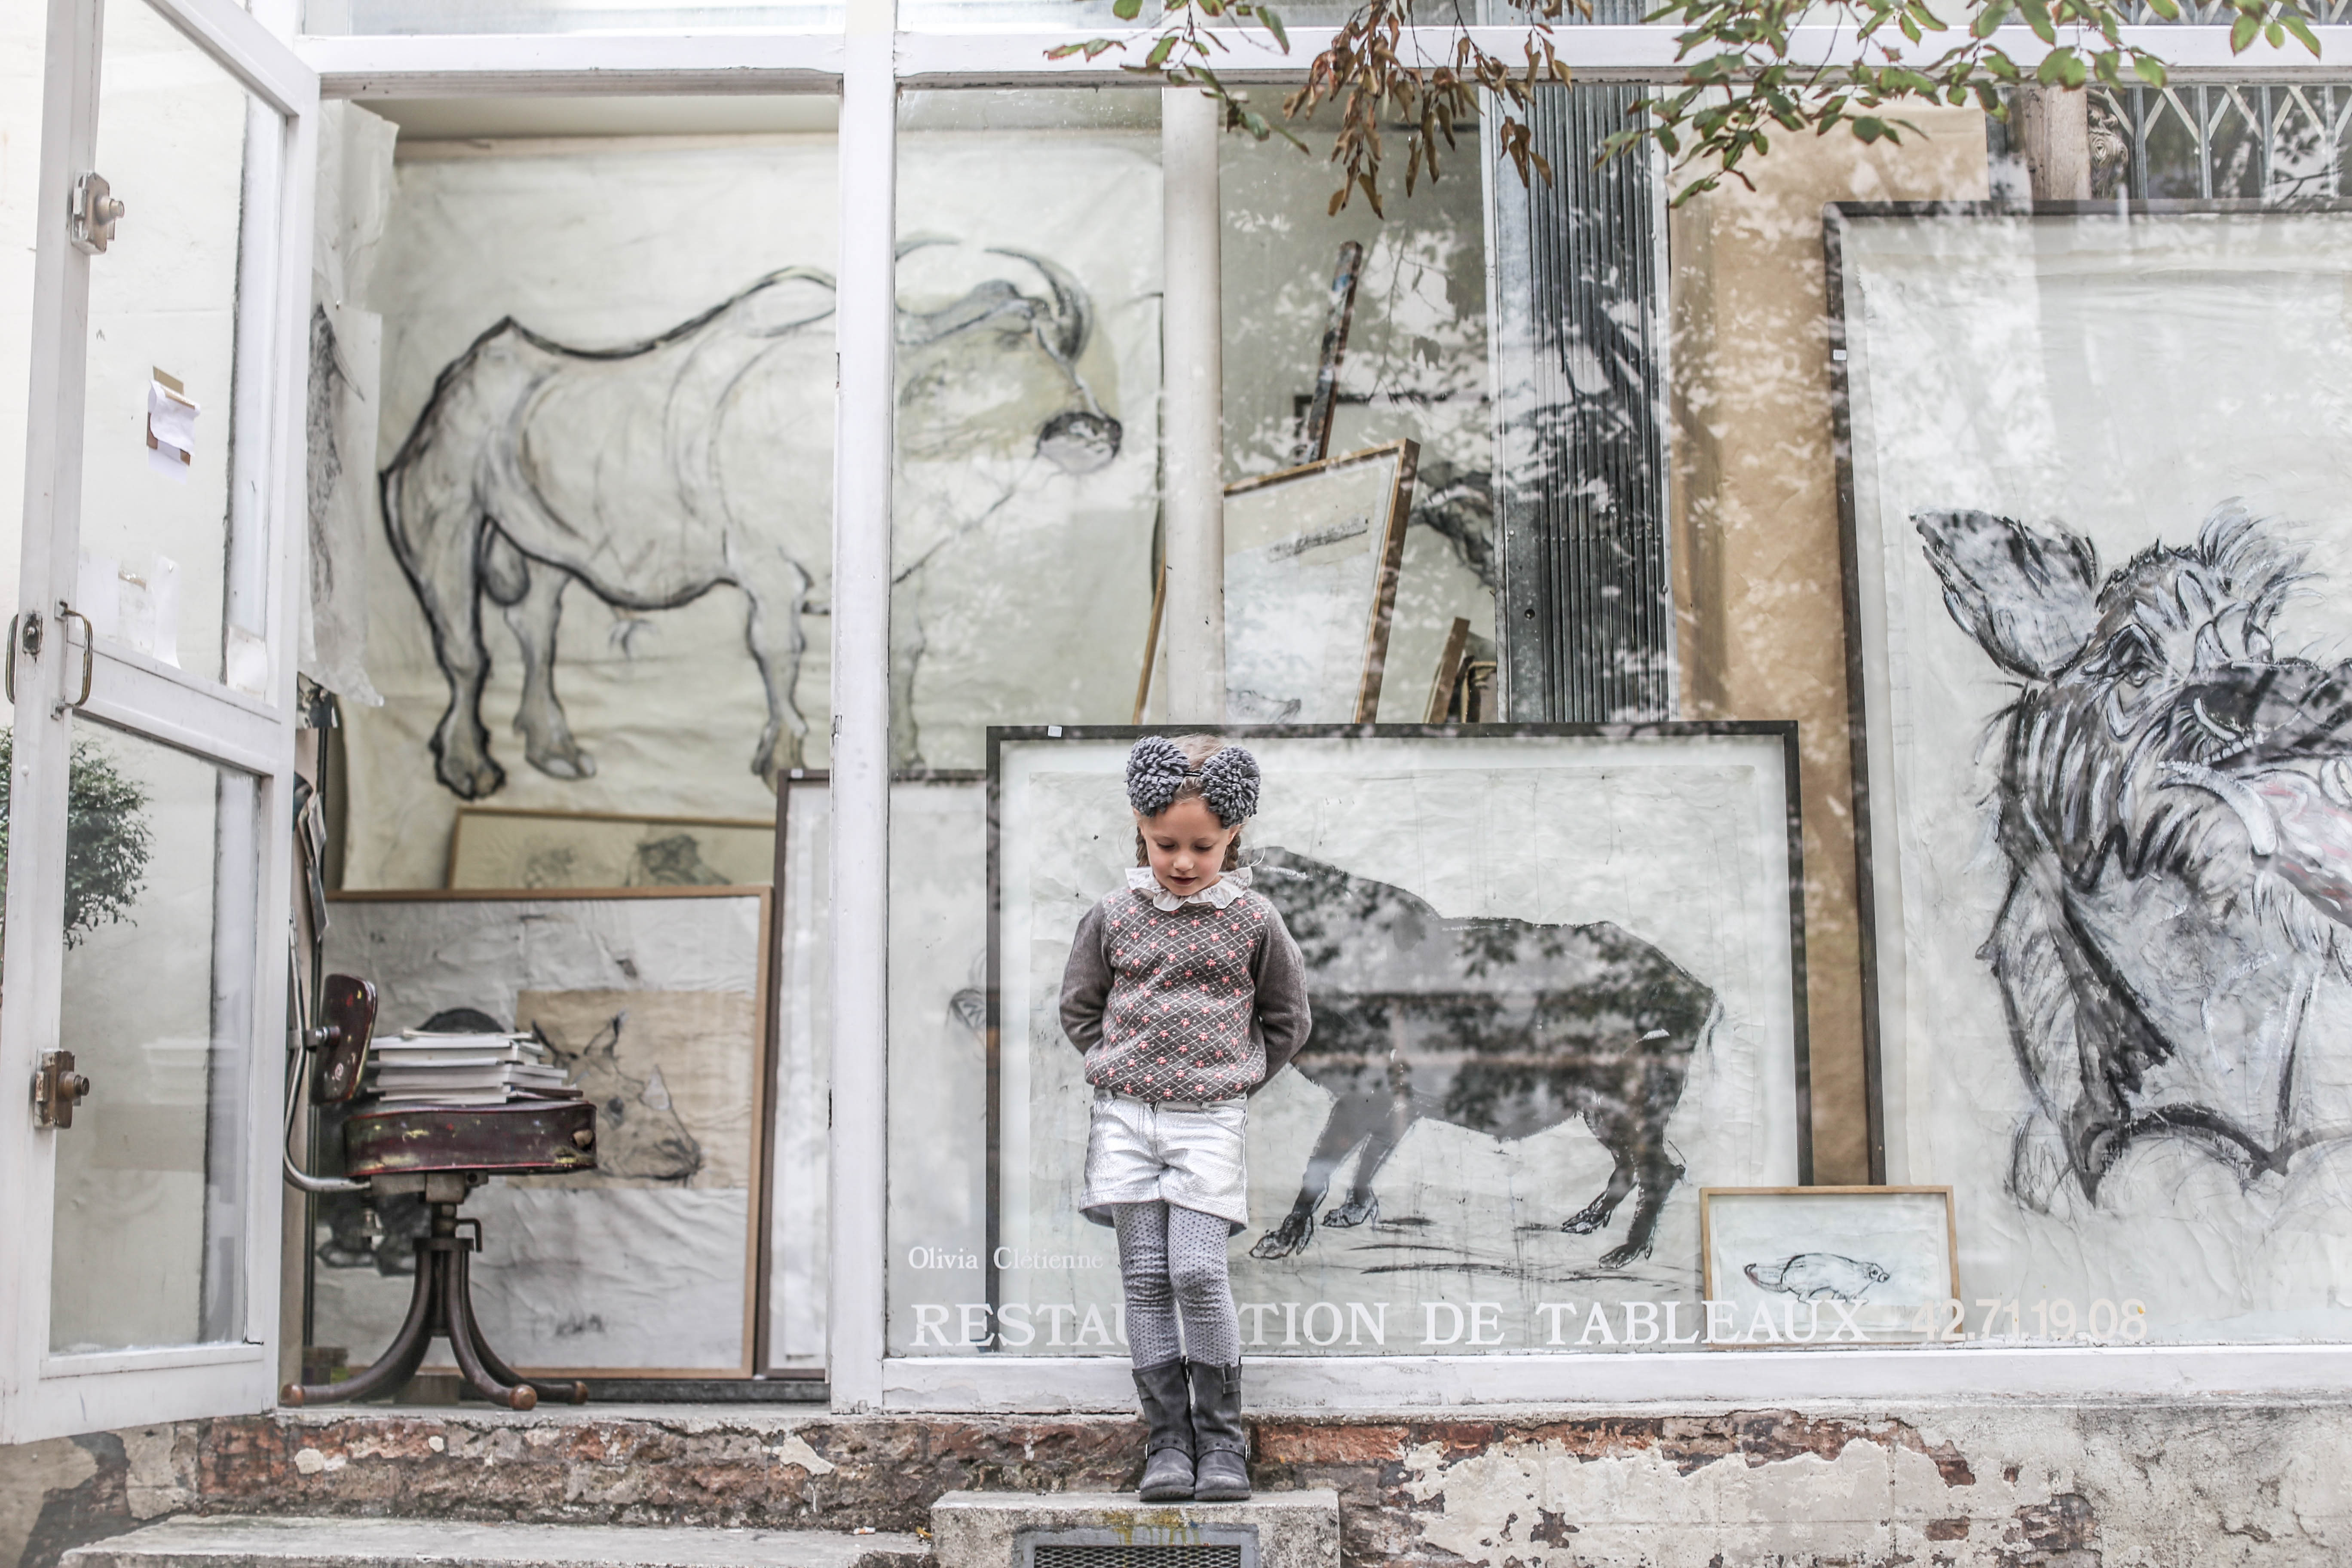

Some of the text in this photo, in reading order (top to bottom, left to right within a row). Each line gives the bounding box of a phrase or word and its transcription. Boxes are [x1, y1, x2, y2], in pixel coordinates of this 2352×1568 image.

[908, 1246, 1104, 1270] Olivia Clétienne
[1420, 1302, 1505, 1346] DE
[1535, 1299, 1871, 1346] TABLEAUX
